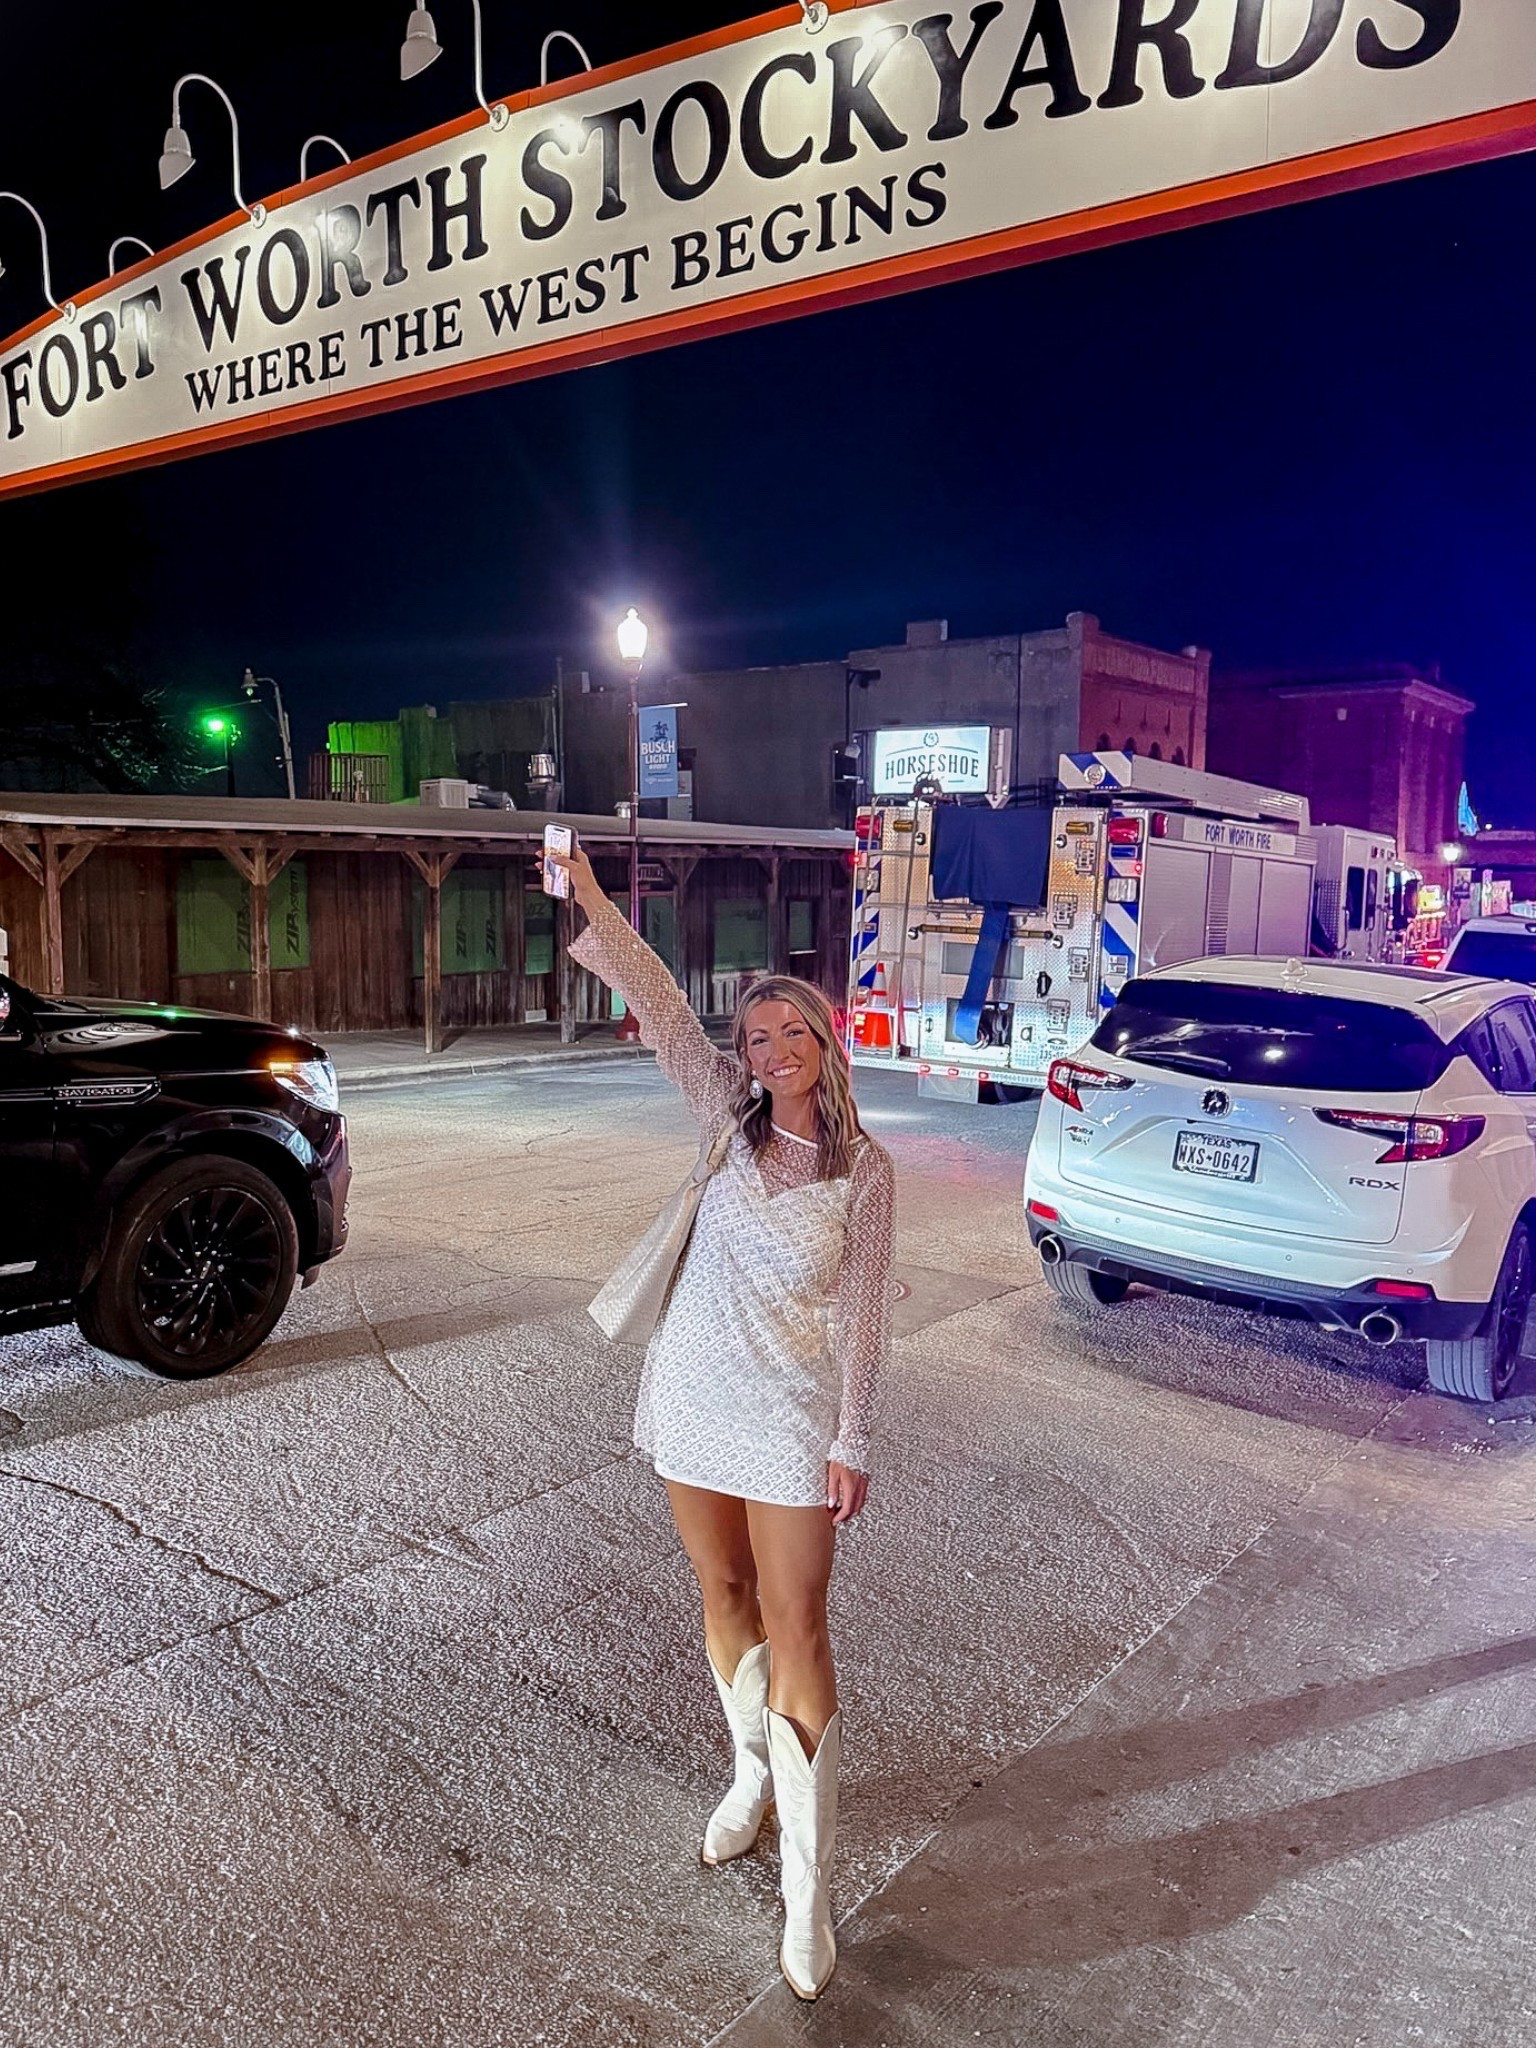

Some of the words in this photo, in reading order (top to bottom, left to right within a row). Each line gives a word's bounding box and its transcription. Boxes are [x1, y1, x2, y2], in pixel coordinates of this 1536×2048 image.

[185, 331, 346, 413] WHERE
[361, 298, 462, 367] THE
[479, 245, 649, 337] WEST
[671, 161, 947, 291] BEGINS
[2, 286, 162, 440] FORT
[181, 154, 488, 352] WORTH
[641, 740, 675, 755] BUSCH
[645, 753, 671, 765] LIGHT
[885, 753, 979, 780] HORSESHOE
[1205, 823, 1225, 843] FORT
[1229, 826, 1255, 847] WORTH
[1256, 831, 1271, 850] FIRE
[58, 1087, 135, 1097] NAVIGATOR
[1202, 1136, 1232, 1149] TEXAS
[1348, 1176, 1400, 1192] RDX
